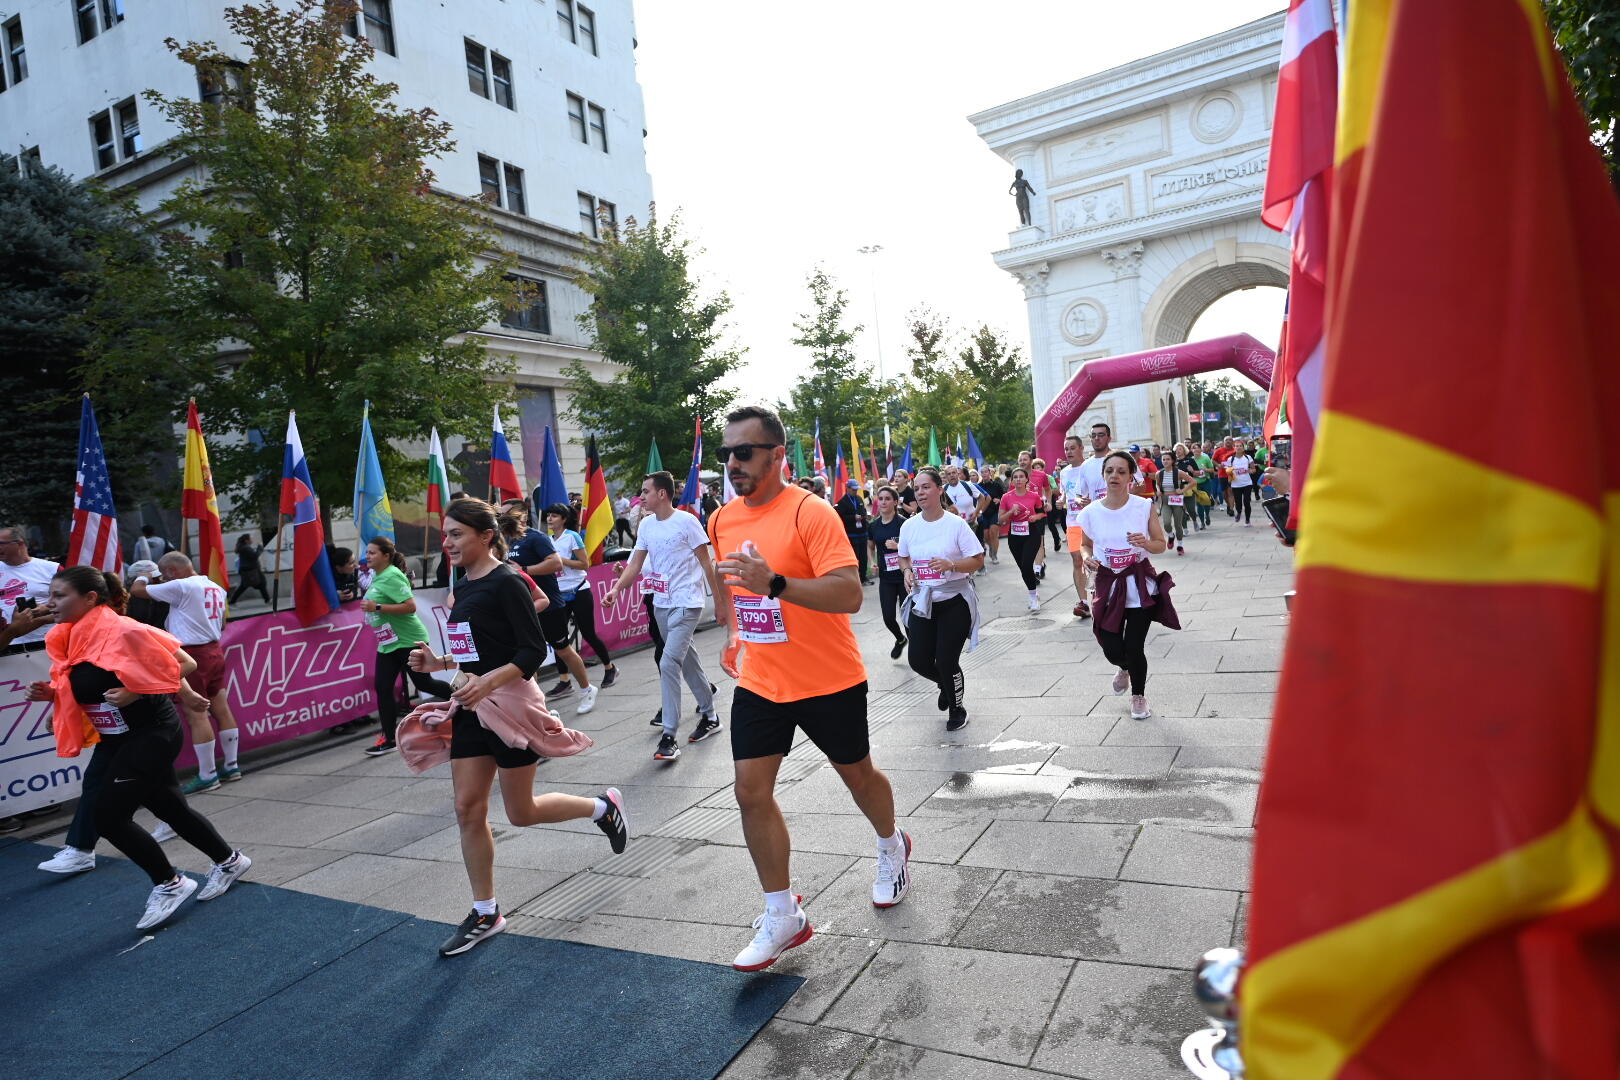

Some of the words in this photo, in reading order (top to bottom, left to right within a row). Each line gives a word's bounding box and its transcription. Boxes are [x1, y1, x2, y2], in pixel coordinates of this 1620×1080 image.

[742, 611, 768, 624] 8790
[619, 623, 650, 640] wizza
[245, 689, 371, 736] wizzair.com
